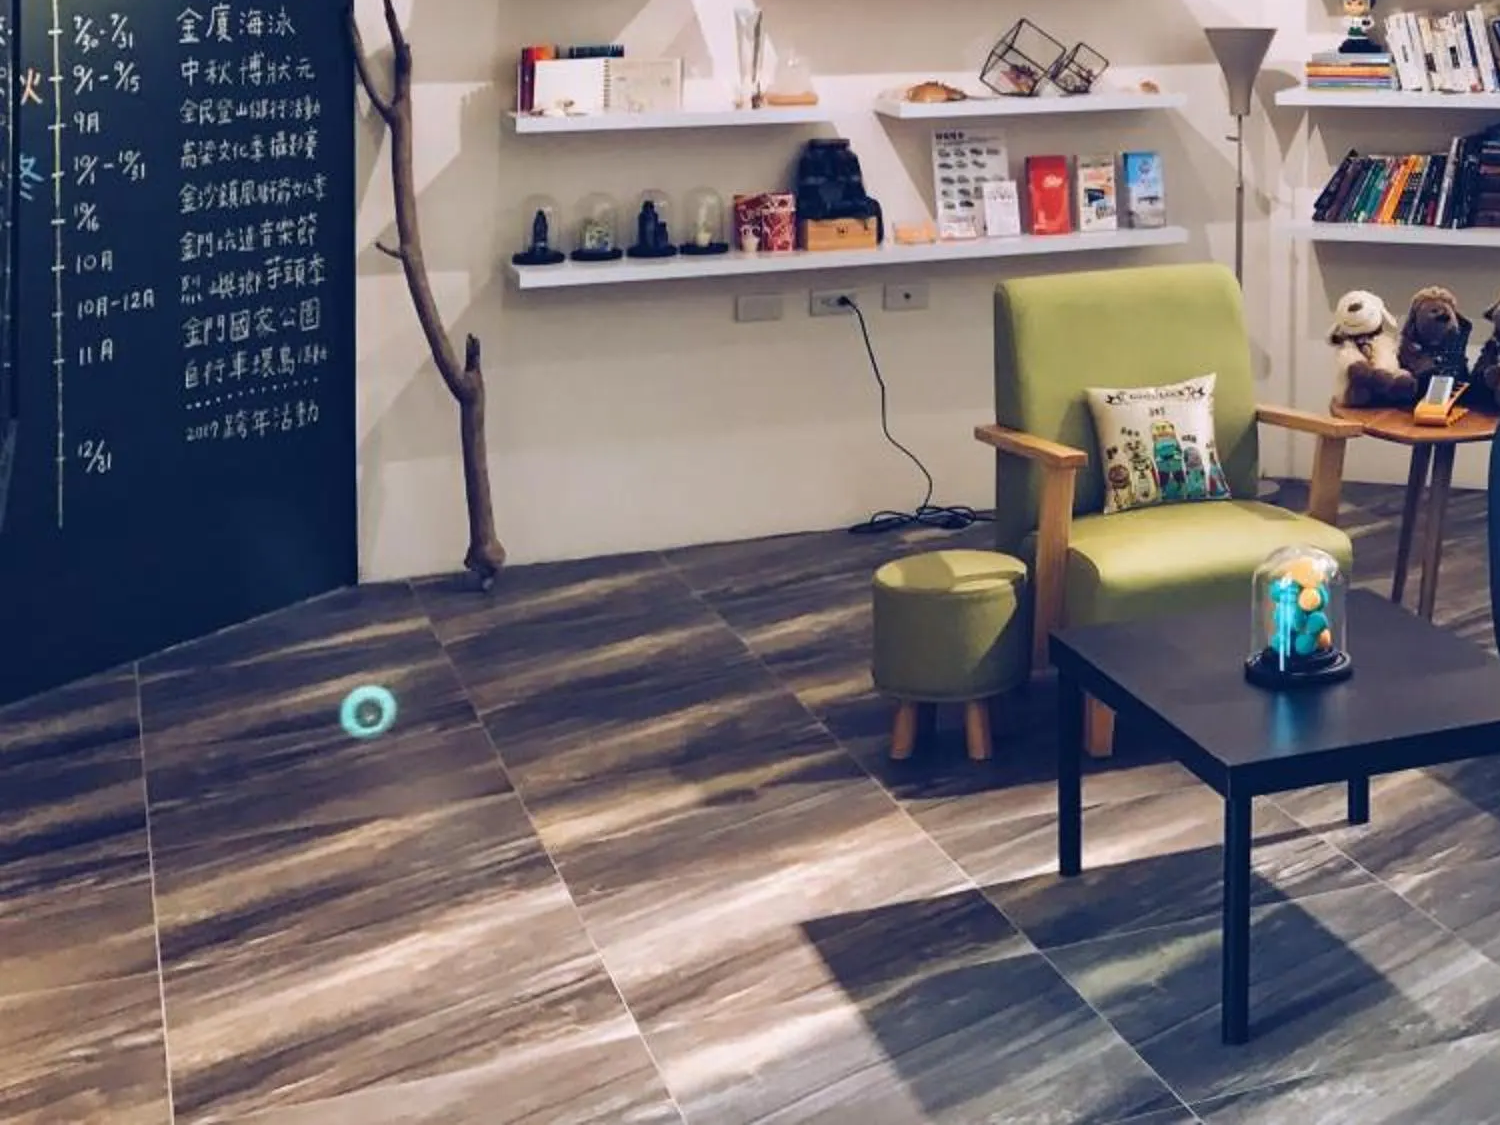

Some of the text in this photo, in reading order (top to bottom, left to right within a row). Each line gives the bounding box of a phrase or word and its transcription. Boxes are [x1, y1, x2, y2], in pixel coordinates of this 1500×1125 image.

[181, 296, 321, 349] 金門國家公園
